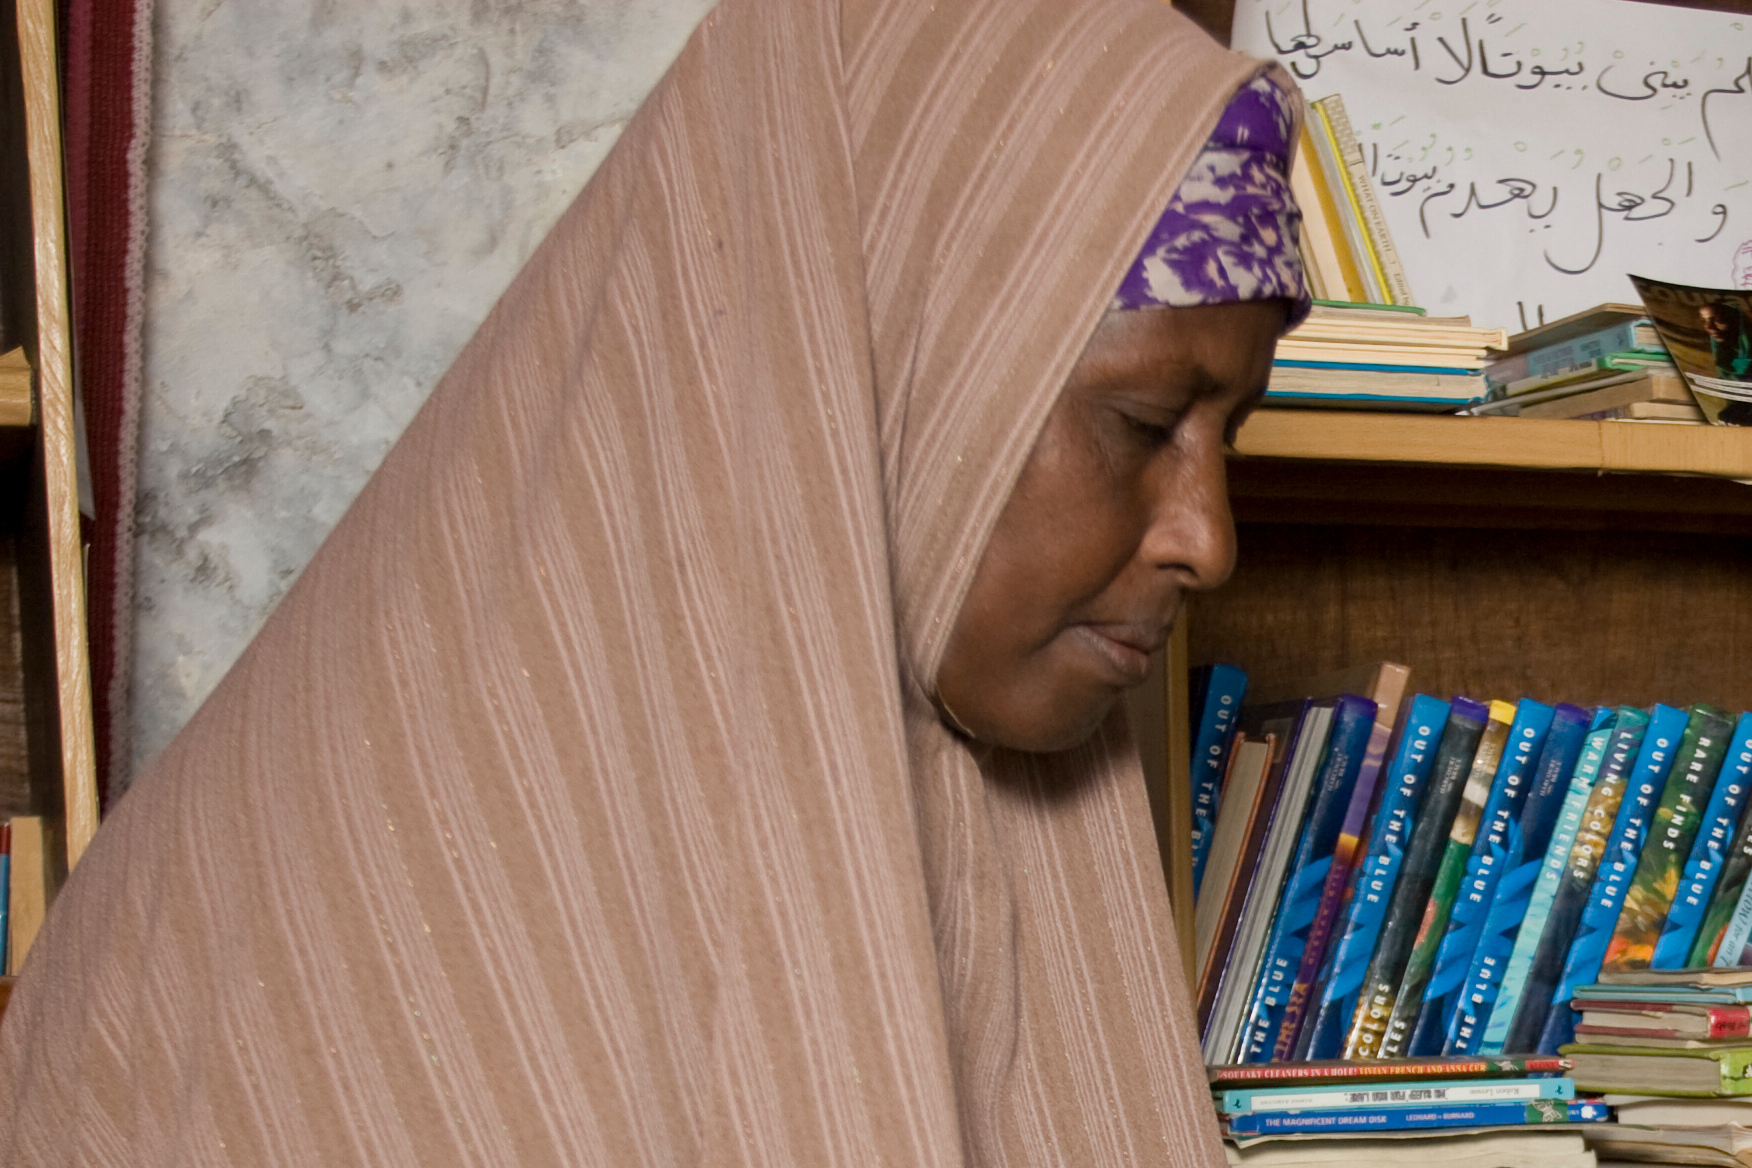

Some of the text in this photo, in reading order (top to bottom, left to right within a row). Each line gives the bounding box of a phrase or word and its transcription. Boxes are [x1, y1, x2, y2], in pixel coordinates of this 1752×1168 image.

[1214, 694, 1233, 733] OUT
[1206, 745, 1221, 769] OF
[1195, 782, 1214, 817] THE
[1367, 725, 1431, 903] OUT OF THE BLUE
[1469, 727, 1535, 903] OUT OF THE BLUE
[1545, 737, 1605, 881] WARM FRIENDS
[1572, 731, 1633, 880] LIVING COLORS
[1600, 738, 1669, 909] OUT OF THE BLUE
[1662, 737, 1711, 850] RARE FINDS
[1724, 783, 1741, 806] OF
[1707, 816, 1729, 850] THE
[1686, 860, 1712, 907] BLUE
[1250, 958, 1289, 1054] THE BLUE
[1358, 983, 1392, 1057] COLORS
[1456, 956, 1496, 1049] THE BLUE
[1223, 1069, 1262, 1079] SQUEAKY
[1264, 1068, 1308, 1078] CLEANERS
[1311, 1068, 1322, 1077] IN
[1323, 1067, 1331, 1076] A
[1389, 1065, 1423, 1075] FRENCH
[1426, 1064, 1442, 1073] AND
[1444, 1063, 1468, 1072] ANNA
[1265, 1115, 1387, 1126] THE MAGNIFICENT DREAM DISK
[1406, 1113, 1437, 1121] LEONARD
